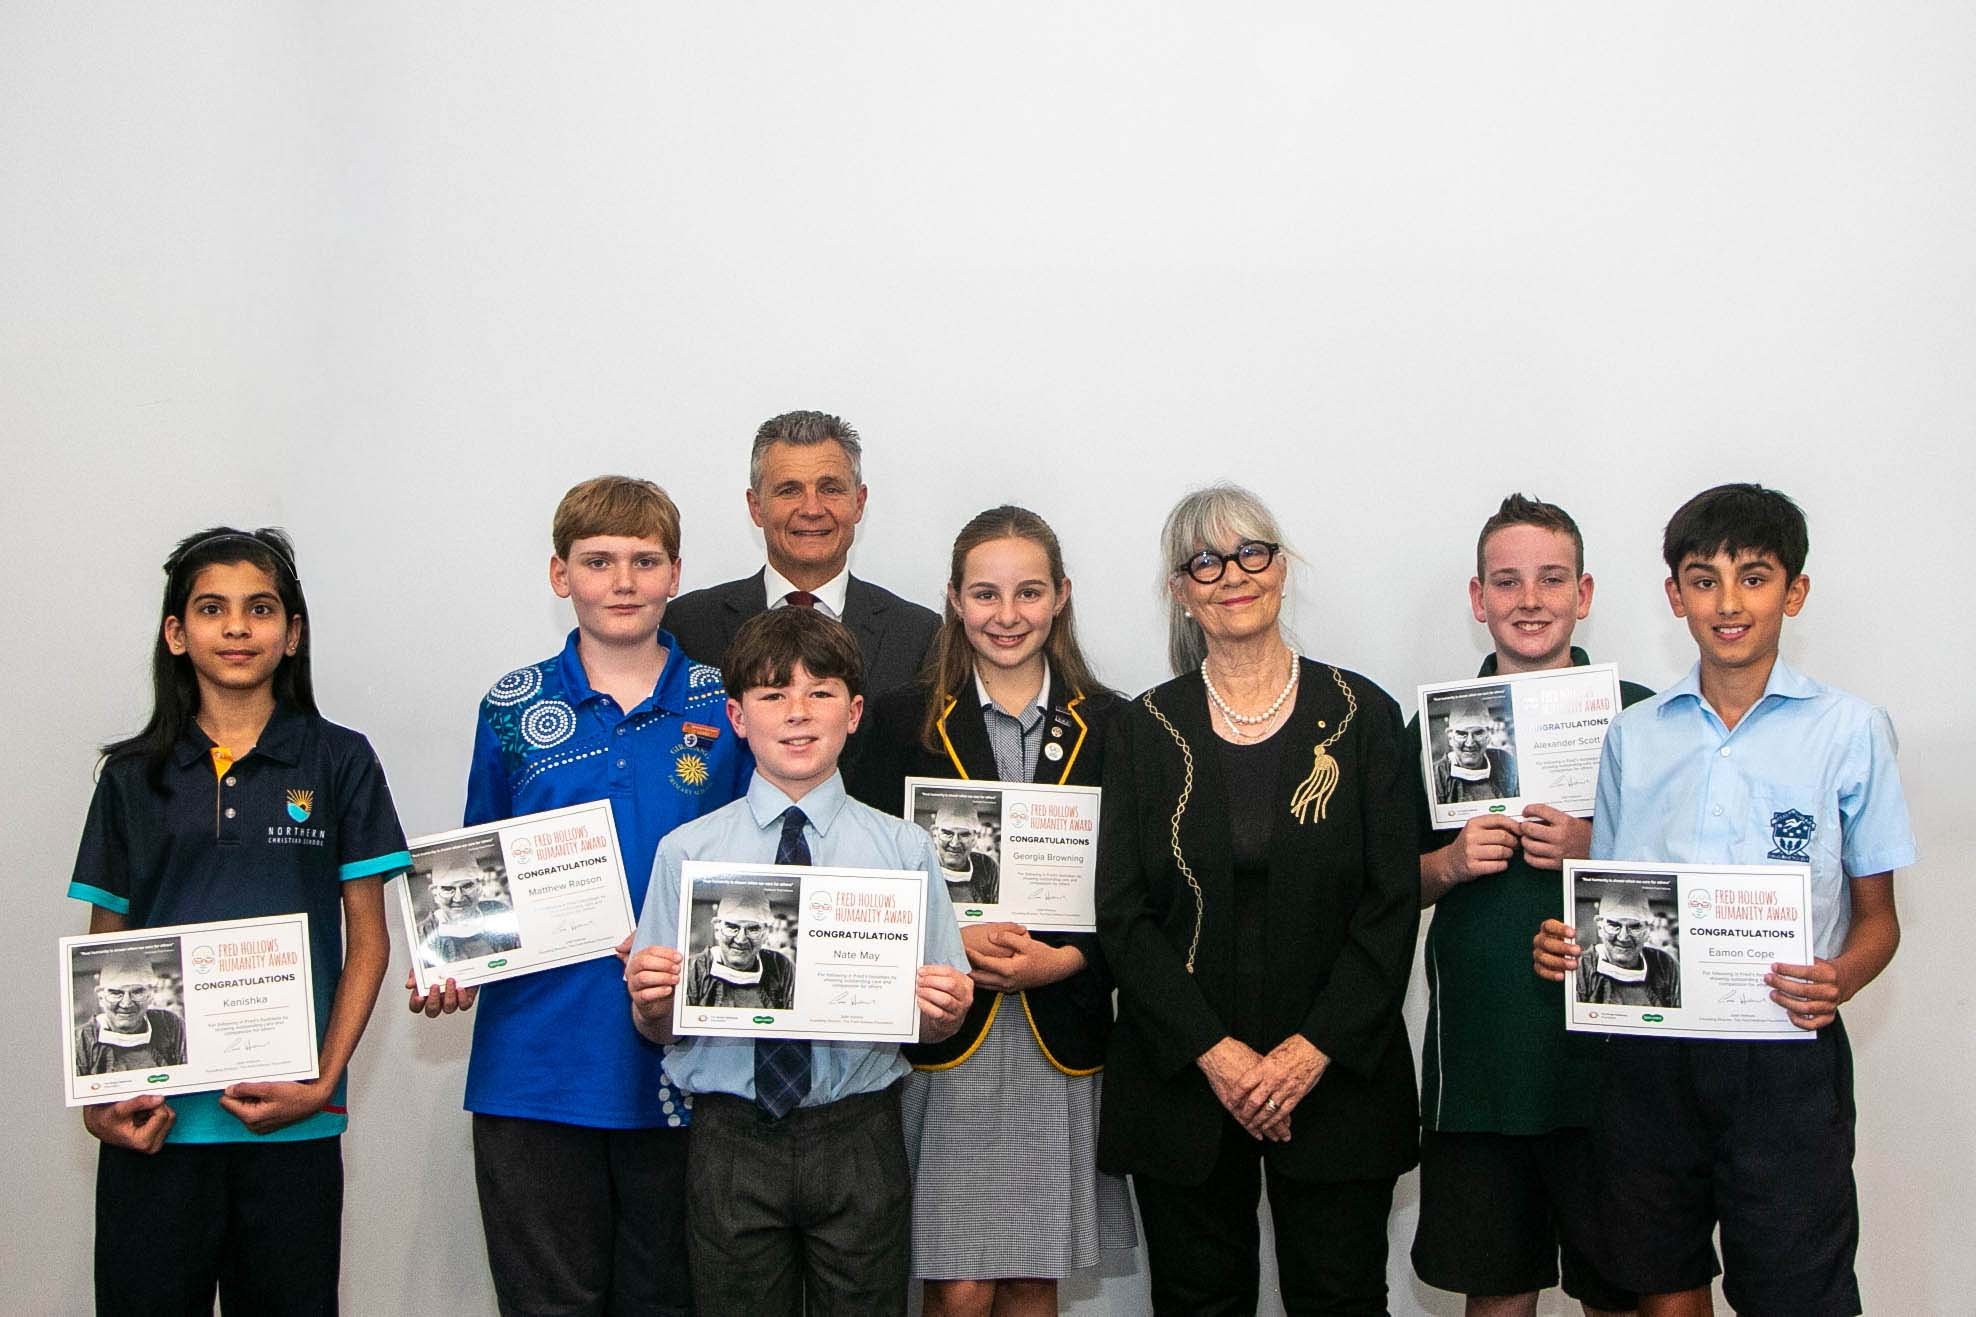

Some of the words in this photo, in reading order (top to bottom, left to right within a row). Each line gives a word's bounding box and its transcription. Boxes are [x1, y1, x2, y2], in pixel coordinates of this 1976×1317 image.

[1534, 739, 1576, 749] Alexander
[1578, 736, 1601, 745] Scott
[1030, 803, 1047, 817] FRED
[1048, 804, 1079, 818] HOLLOWS
[1030, 817, 1068, 831] HUMANITY
[1069, 818, 1093, 832] AWARD
[268, 826, 325, 839] NORTHERN
[534, 830, 553, 846] FRED
[554, 825, 589, 842] HOLLOWS
[536, 844, 579, 861] HUMANITY
[580, 835, 607, 851] AWARD
[1009, 835, 1090, 846] CONGRATULATIONS
[1013, 851, 1045, 862] Georgia
[1047, 853, 1084, 864] Browning
[517, 855, 608, 881] CONGRATULATIONS
[528, 882, 567, 897] Matthew
[568, 875, 602, 890] Rapson
[836, 891, 855, 906] FRED
[858, 892, 896, 907] HOLLOWS
[1715, 889, 1735, 905] FRED
[1738, 890, 1778, 906] HOLLOWS
[835, 909, 882, 924] HUMANITY
[883, 909, 913, 925] AWARD
[1715, 905, 1764, 921] HUMANITY
[1766, 906, 1798, 922] AWARD
[808, 929, 909, 941] CONGRATULATIONS
[1689, 927, 1795, 939] CONGRATULATIONS
[218, 942, 239, 959] FRED
[241, 938, 279, 956] HOLLOWS
[1708, 947, 1744, 958] Eamon
[1747, 949, 1775, 960] Cope
[219, 953, 267, 973] HUMANITY
[268, 950, 298, 967] AWARD
[833, 949, 857, 960] Nate
[859, 950, 880, 964] May
[194, 973, 296, 991] CONGRATULATIONS
[223, 995, 269, 1008] Kanishka
